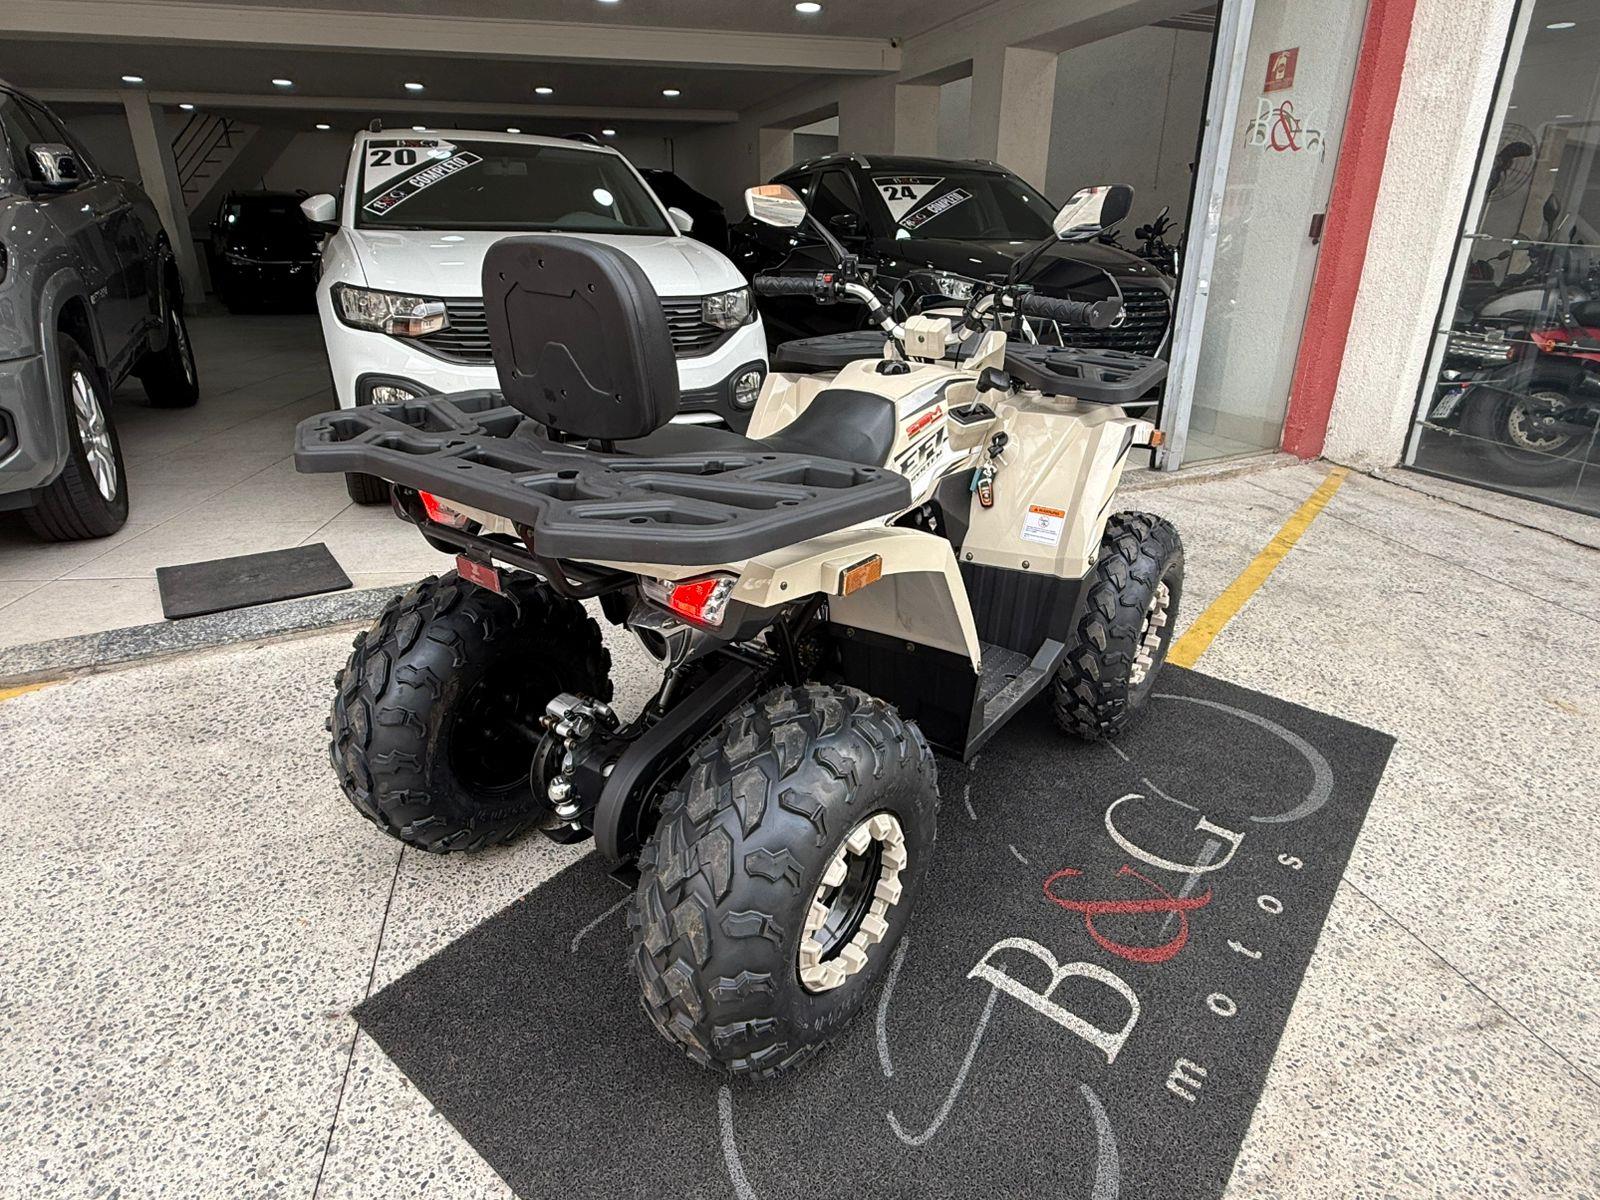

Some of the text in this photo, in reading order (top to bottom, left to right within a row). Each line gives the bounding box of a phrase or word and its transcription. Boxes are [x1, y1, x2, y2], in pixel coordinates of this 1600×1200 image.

[370, 149, 417, 167] 20
[409, 157, 469, 188] COMPLETO
[883, 186, 918, 200] 24
